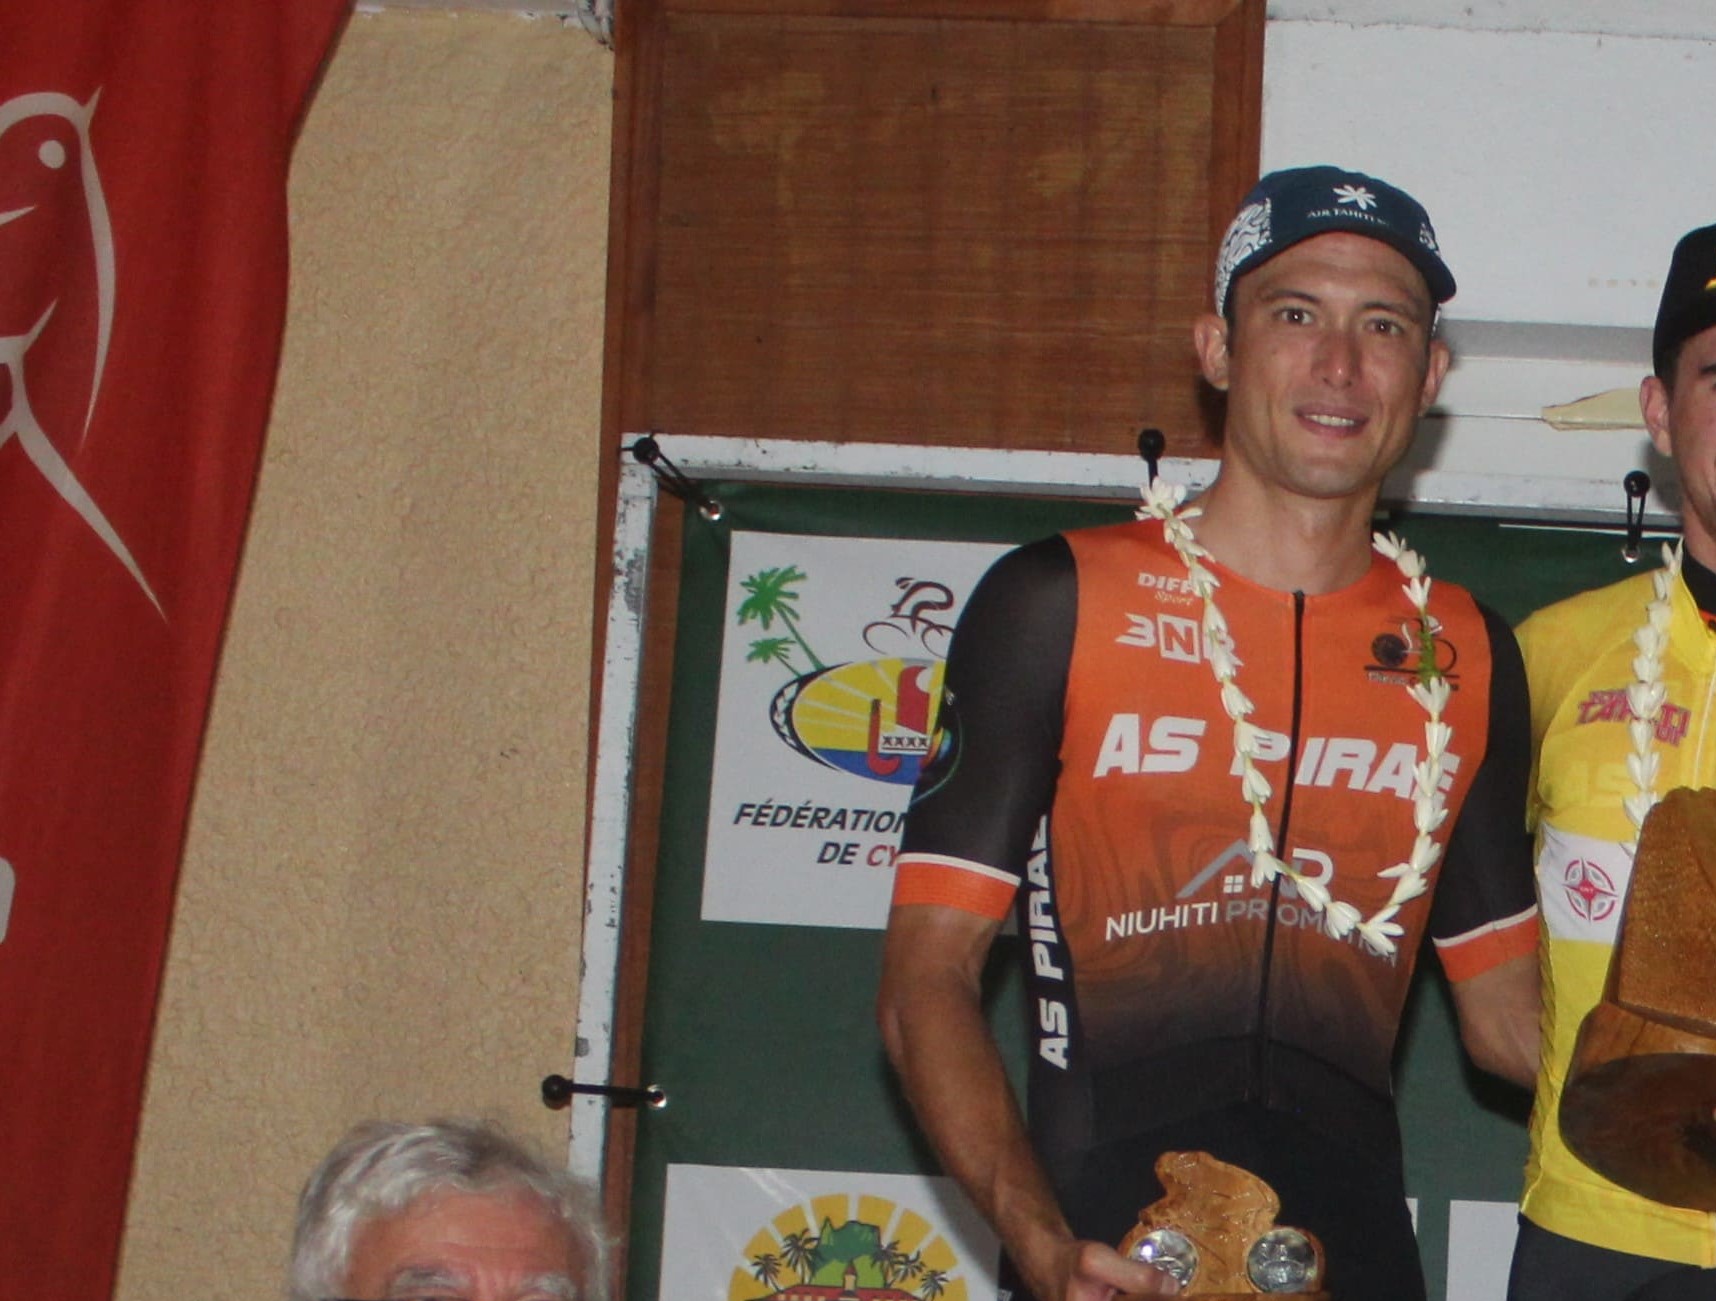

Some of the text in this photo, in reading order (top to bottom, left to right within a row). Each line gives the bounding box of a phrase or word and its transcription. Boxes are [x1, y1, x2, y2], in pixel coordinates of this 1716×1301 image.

[1307, 210, 1332, 219] AIR
[1332, 207, 1376, 222] TAHITI
[1092, 713, 1207, 779] AS
[817, 842, 861, 866] DE
[1105, 901, 1219, 942] NIUHITI
[1038, 998, 1070, 1071] AS
